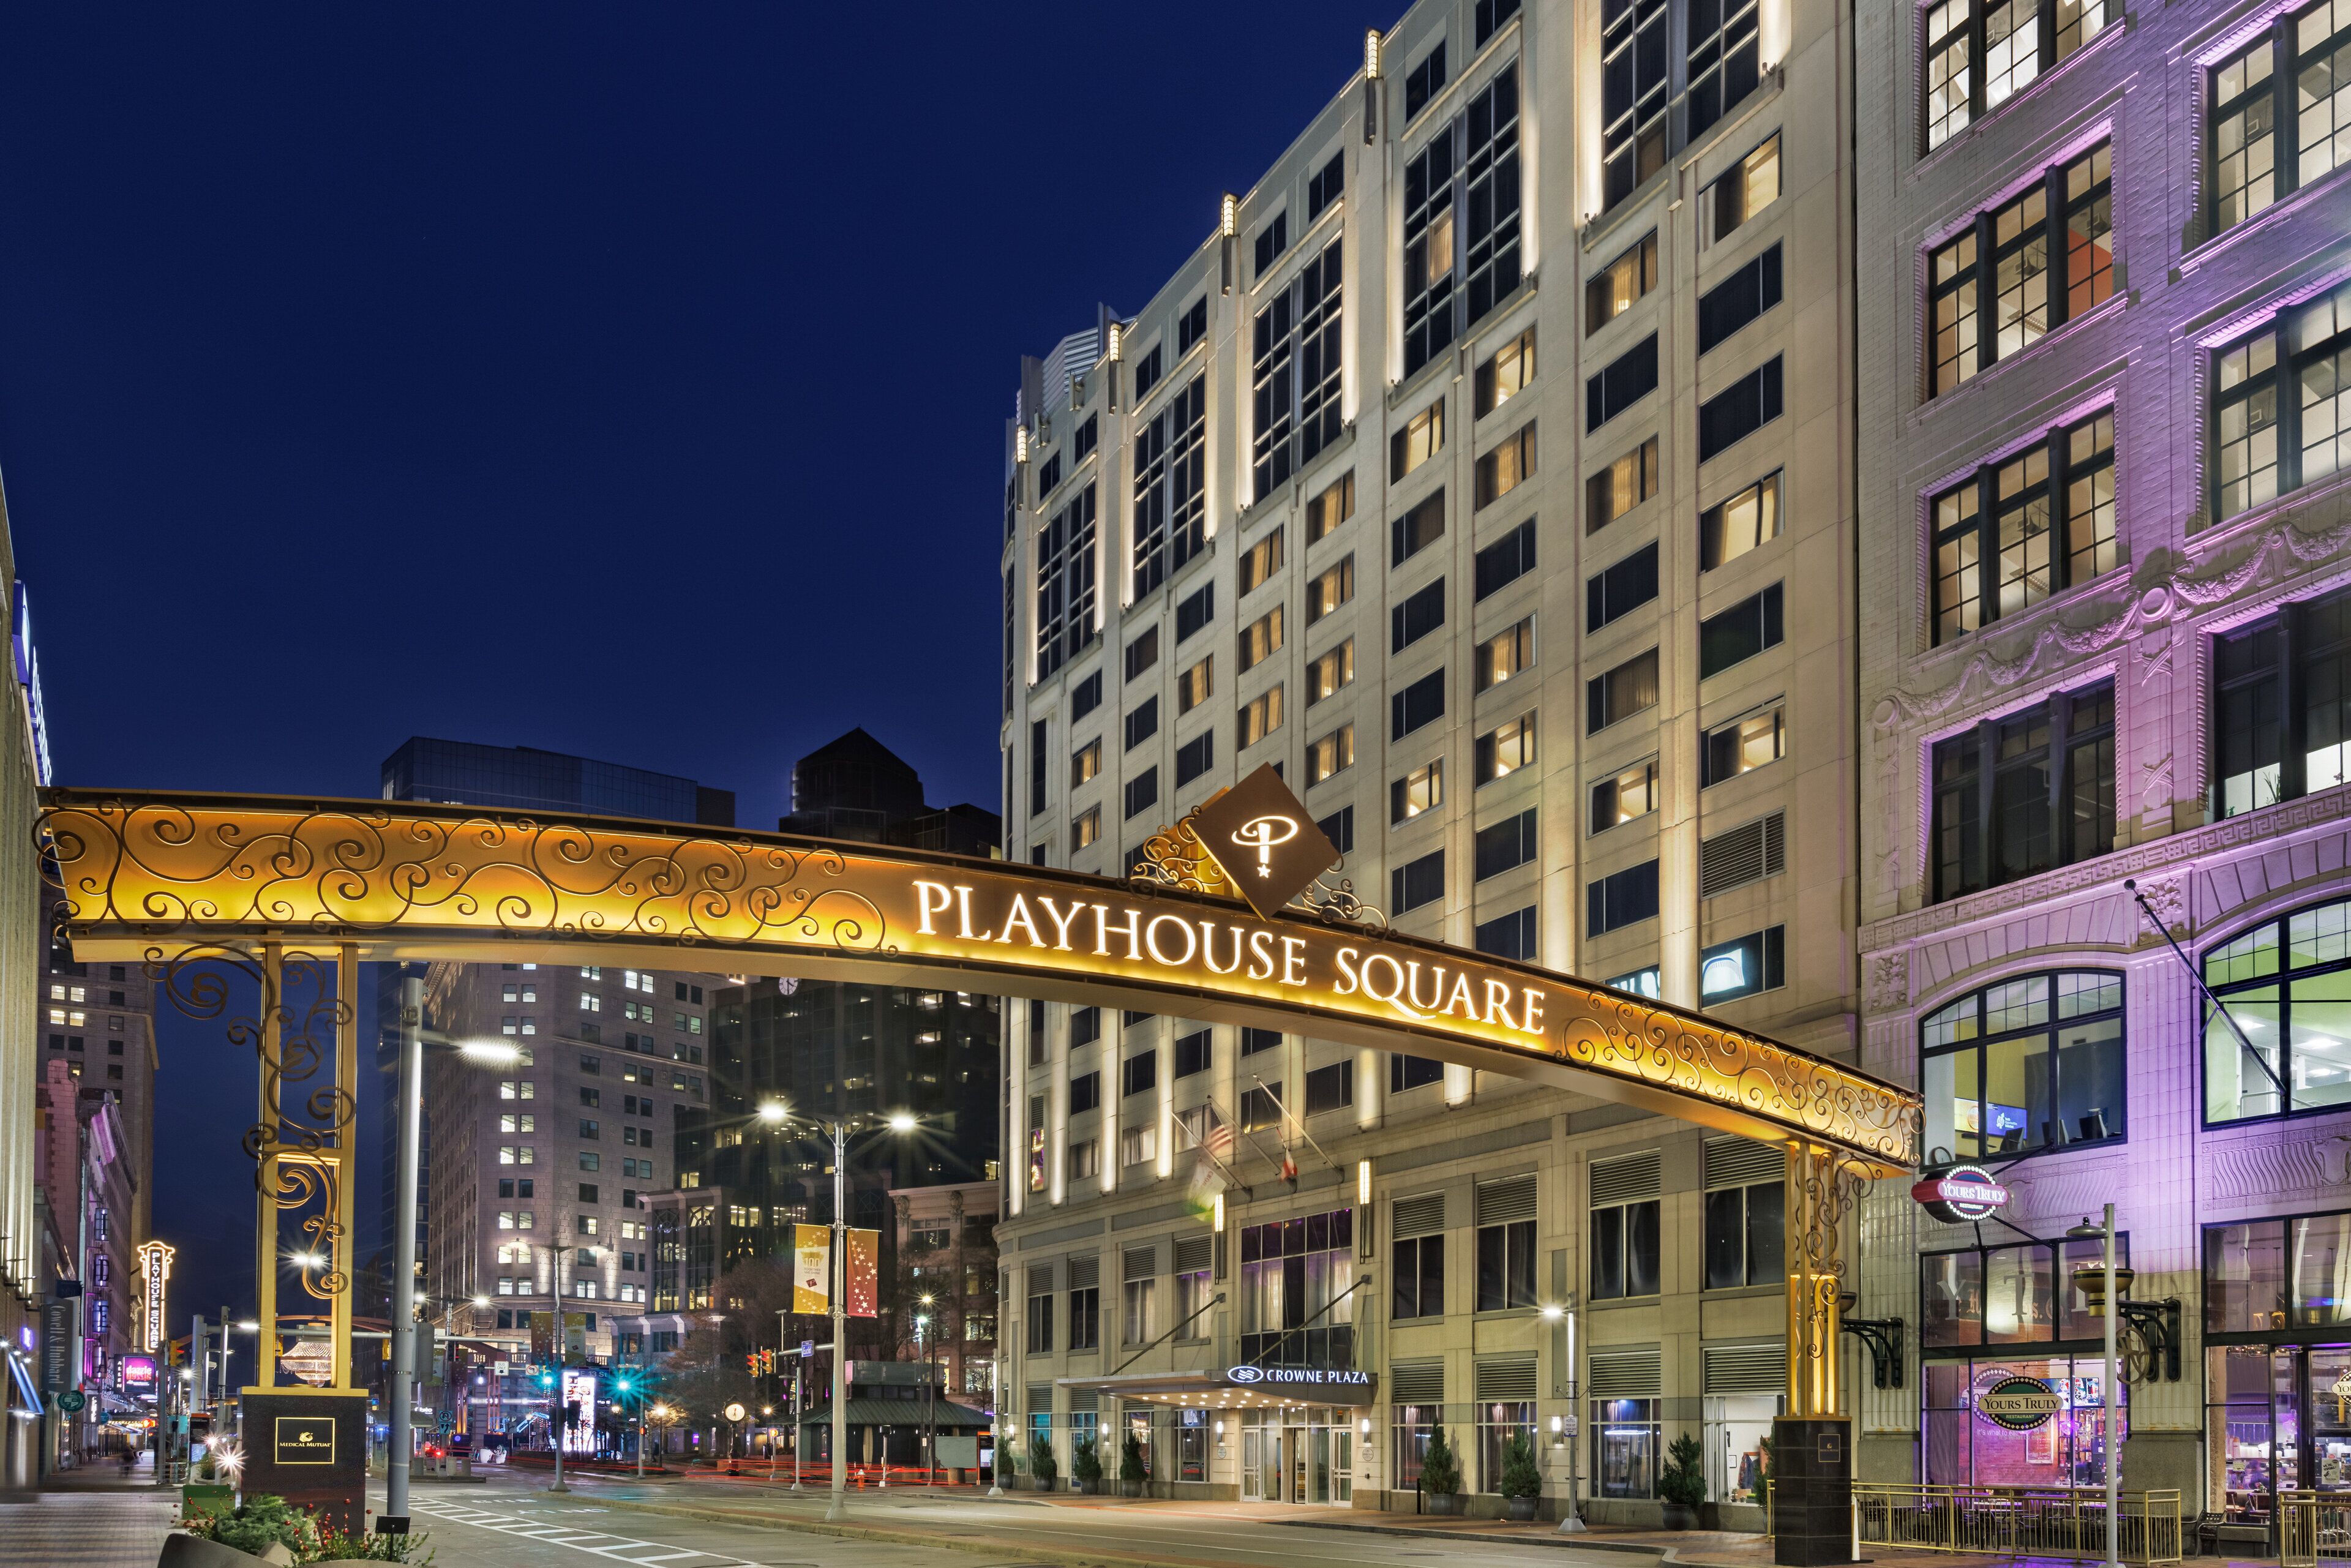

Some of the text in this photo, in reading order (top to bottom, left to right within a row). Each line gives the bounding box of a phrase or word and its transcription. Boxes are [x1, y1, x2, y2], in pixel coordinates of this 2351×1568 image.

[912, 879, 1546, 1036] PLAYHOUSE SQUARE
[1942, 1182, 2005, 1202] YOURS TRULY
[803, 1258, 821, 1267] 100
[150, 1252, 160, 1348] PLAYHOUSE SQUARE
[49, 1305, 66, 1334] Cowell
[802, 1346, 812, 1355] Euclid
[48, 1346, 65, 1384] Hubbard
[126, 1365, 152, 1375] dazzle
[1267, 1370, 1368, 1384] CROWNE PLAZA
[1984, 1397, 2058, 1409] YOURS TRULY
